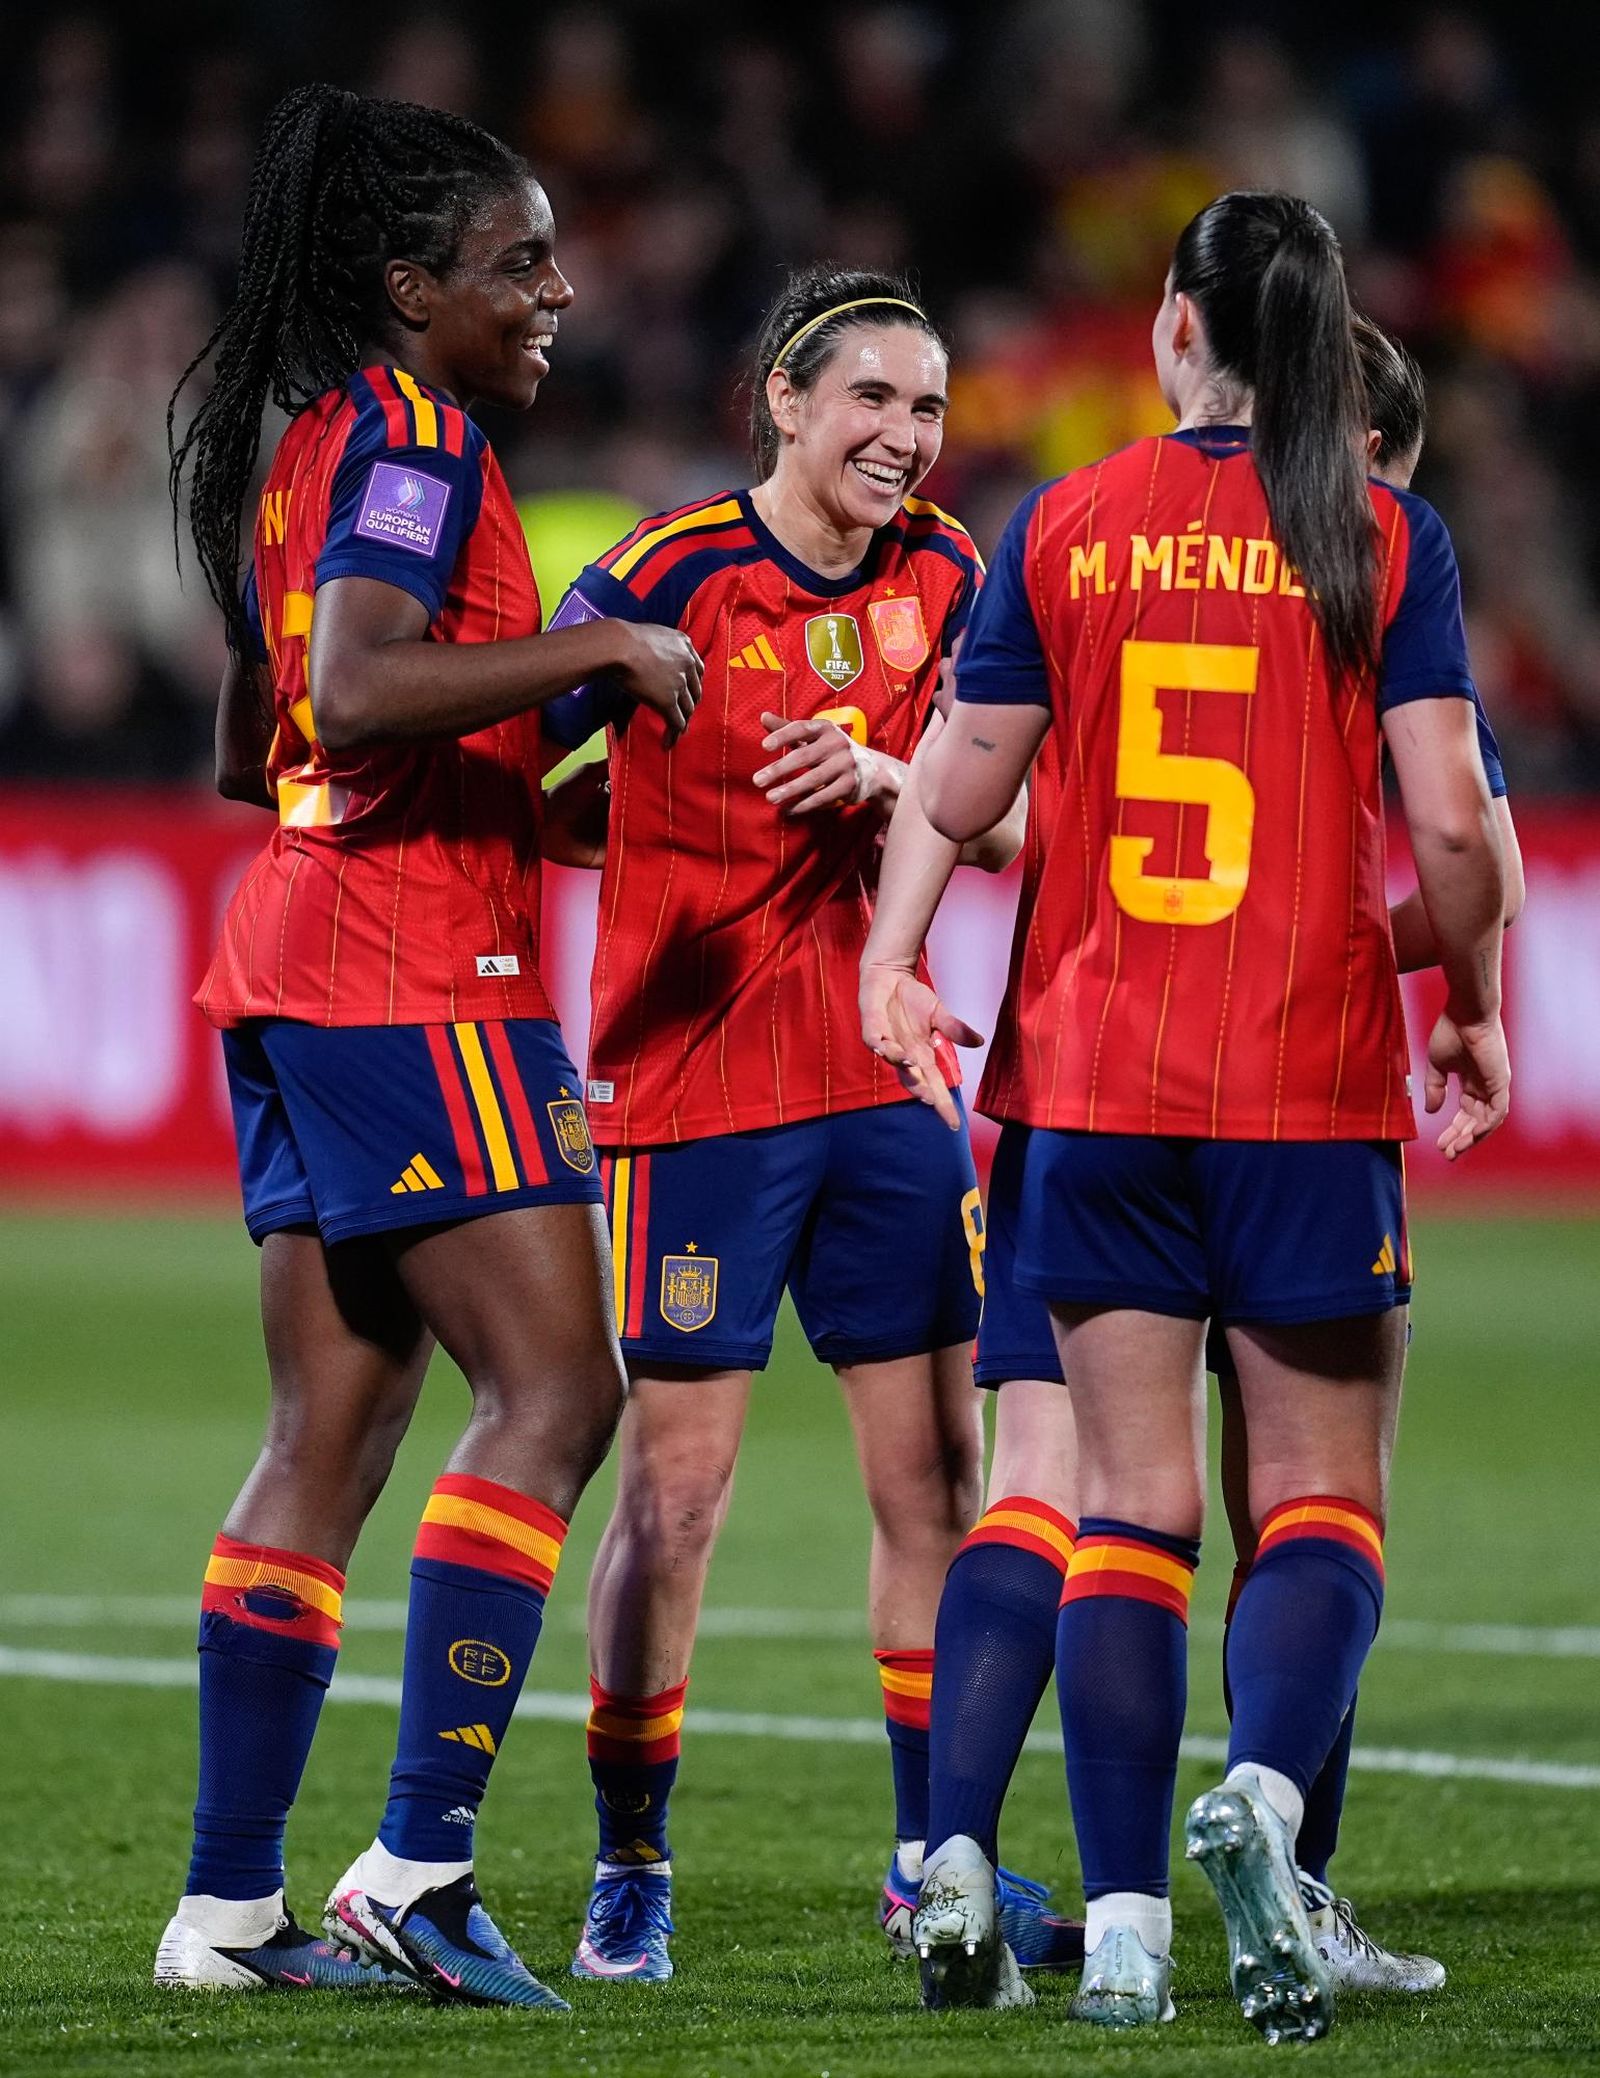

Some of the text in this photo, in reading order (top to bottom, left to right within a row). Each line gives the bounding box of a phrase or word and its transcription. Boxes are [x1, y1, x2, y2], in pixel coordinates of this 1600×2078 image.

[365, 518, 430, 545] QUALIFIERS
[369, 510, 431, 536] EUROPEAN
[1069, 519, 1318, 600] M. MÉNDE
[825, 660, 850, 671] FIFA
[1109, 640, 1260, 926] 5
